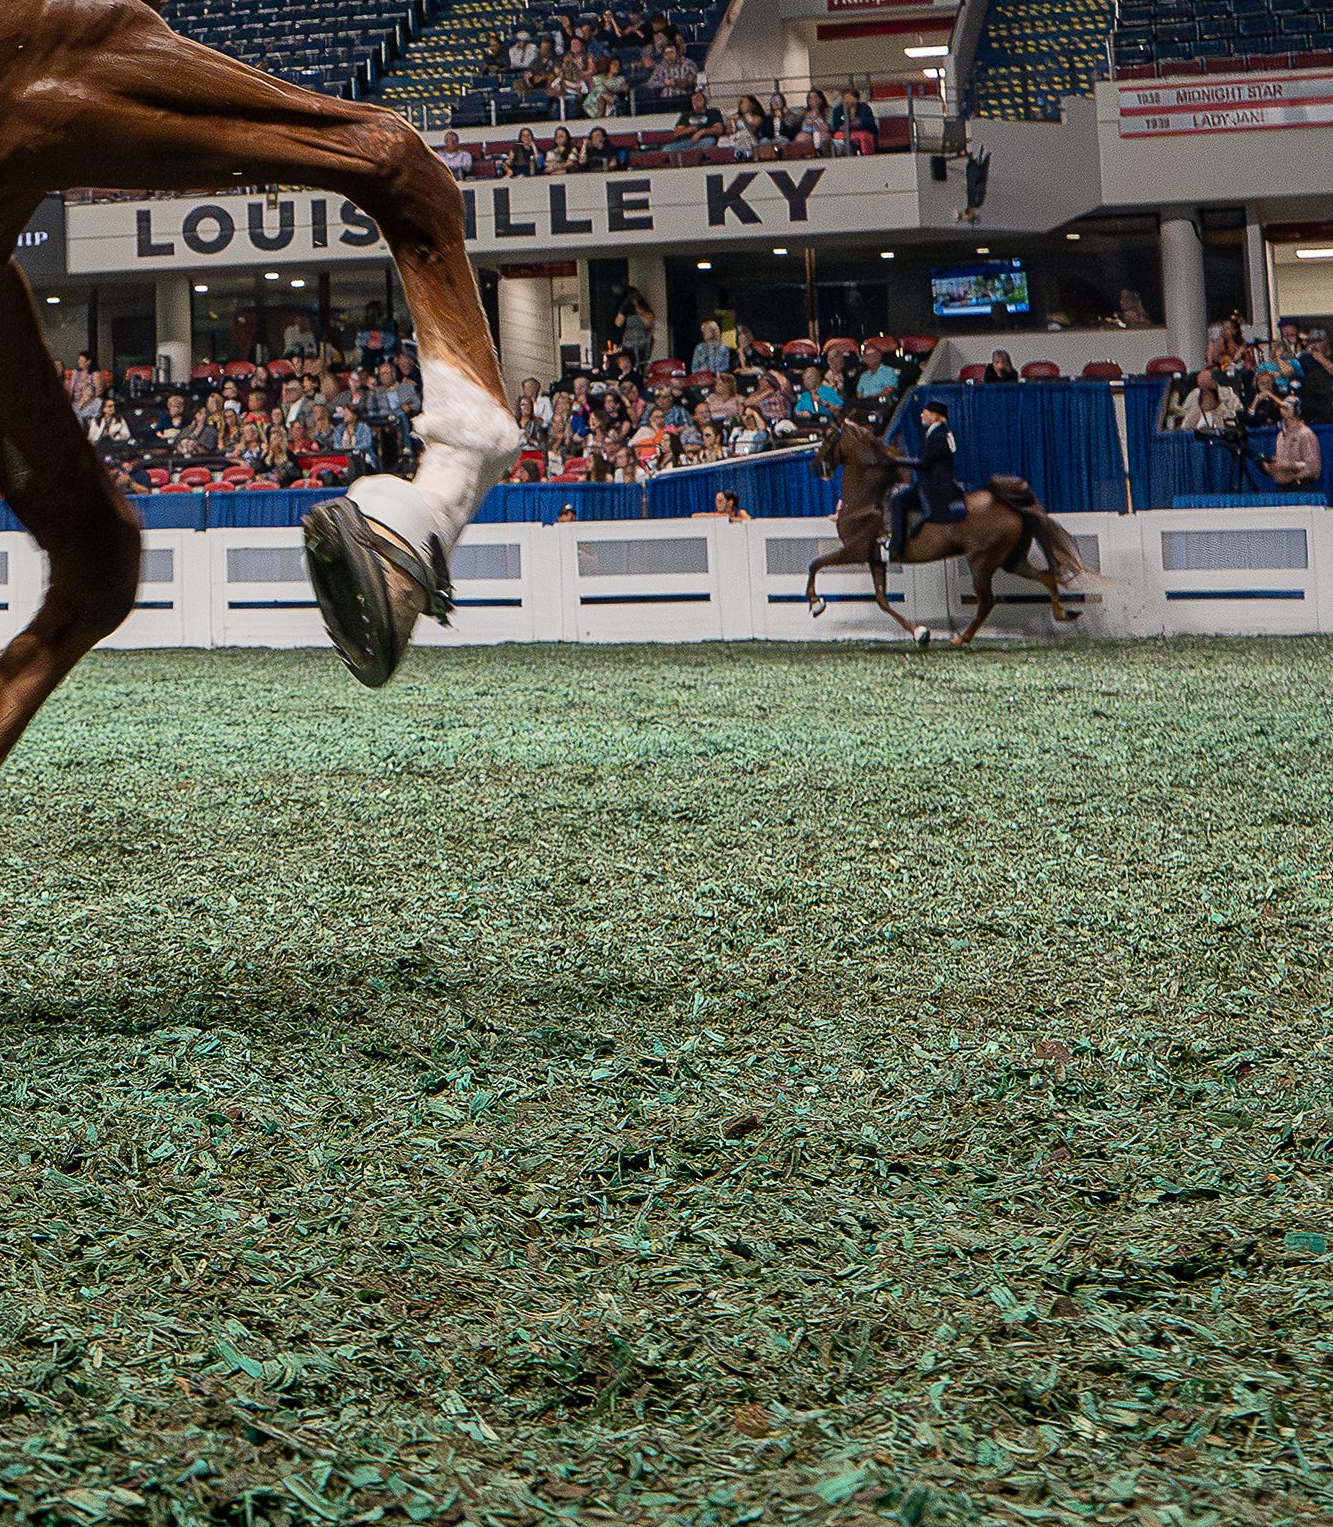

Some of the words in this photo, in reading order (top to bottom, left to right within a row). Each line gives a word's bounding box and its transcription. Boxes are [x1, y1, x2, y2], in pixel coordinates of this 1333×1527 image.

[1175, 85, 1242, 105] MIDNIGHT
[1247, 84, 1283, 99] STAR
[135, 179, 654, 258] LOUISILLE
[706, 167, 825, 226] KY
